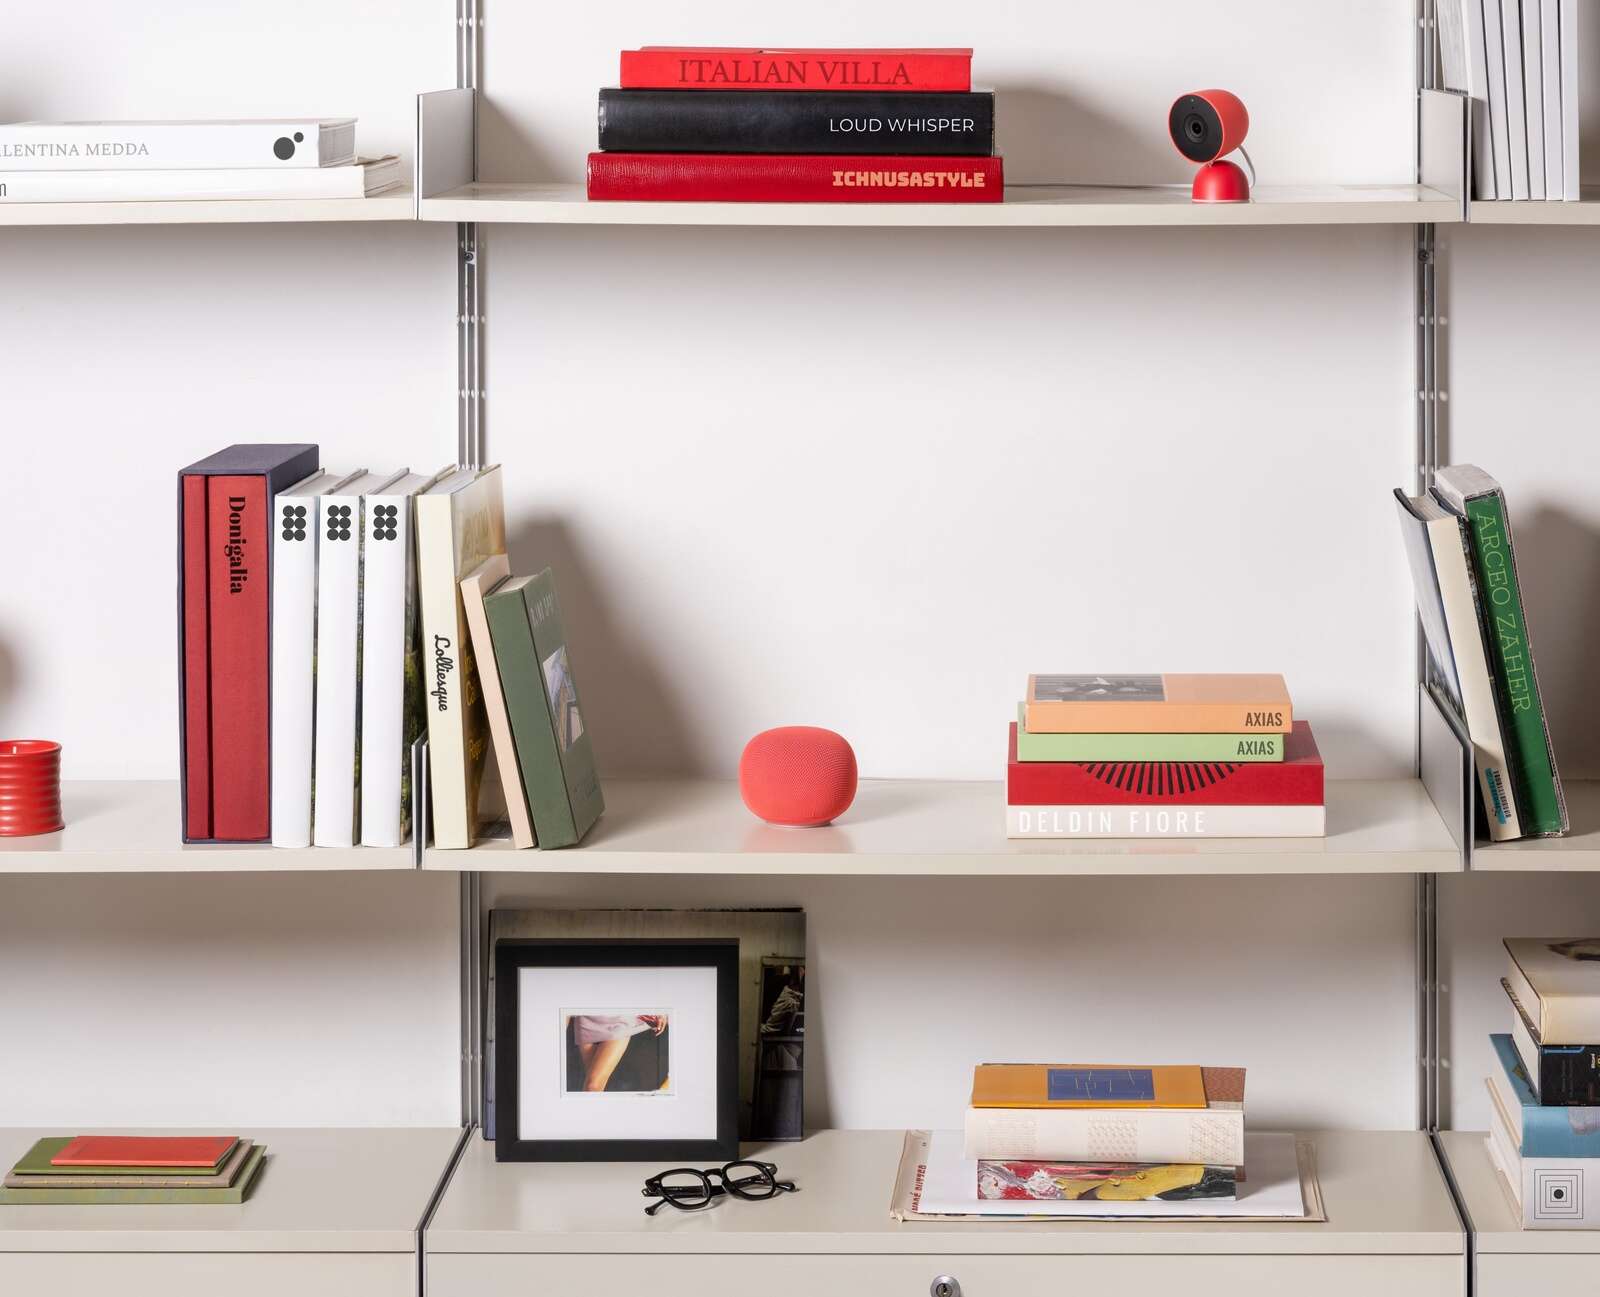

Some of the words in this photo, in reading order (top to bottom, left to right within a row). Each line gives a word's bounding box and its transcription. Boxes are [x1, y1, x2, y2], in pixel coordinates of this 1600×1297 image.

[678, 60, 807, 84] ITALIAN
[815, 61, 912, 85] VILLA
[829, 118, 882, 132] LOUD
[888, 118, 975, 132] WHISPER
[0, 143, 79, 157] LENTINA
[86, 143, 149, 156] MEDDA
[832, 170, 985, 188] ICHNUSASTYLE
[224, 496, 248, 594] Donigalia
[1476, 514, 1511, 606] ARCEO
[1496, 614, 1531, 713] ZAHER
[430, 634, 454, 712] Lolliesque
[1245, 712, 1283, 727] AXIAS
[1237, 740, 1275, 756] AXIAS
[1019, 811, 1112, 833] DELDIN
[1129, 811, 1206, 833] FIORE
